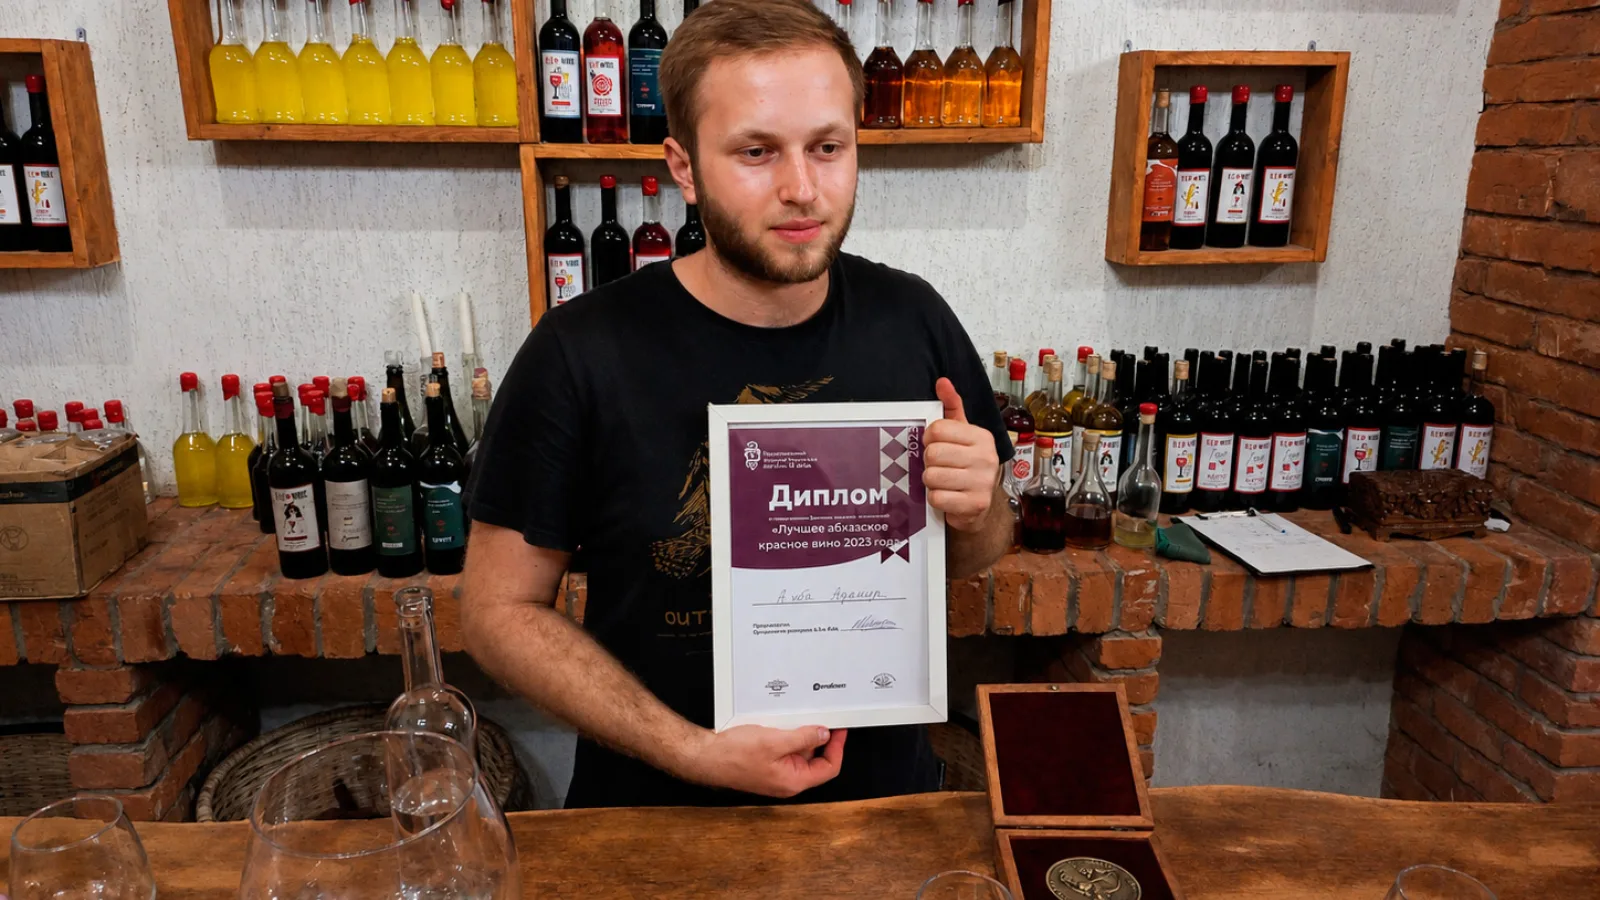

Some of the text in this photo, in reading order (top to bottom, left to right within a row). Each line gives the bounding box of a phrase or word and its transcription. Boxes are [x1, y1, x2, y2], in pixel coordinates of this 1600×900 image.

[768, 484, 889, 511] Диплом
[772, 522, 889, 535] «Лучшее абхазское
[758, 540, 809, 551] красное
[812, 540, 841, 548] вино
[843, 537, 872, 547] 2023
